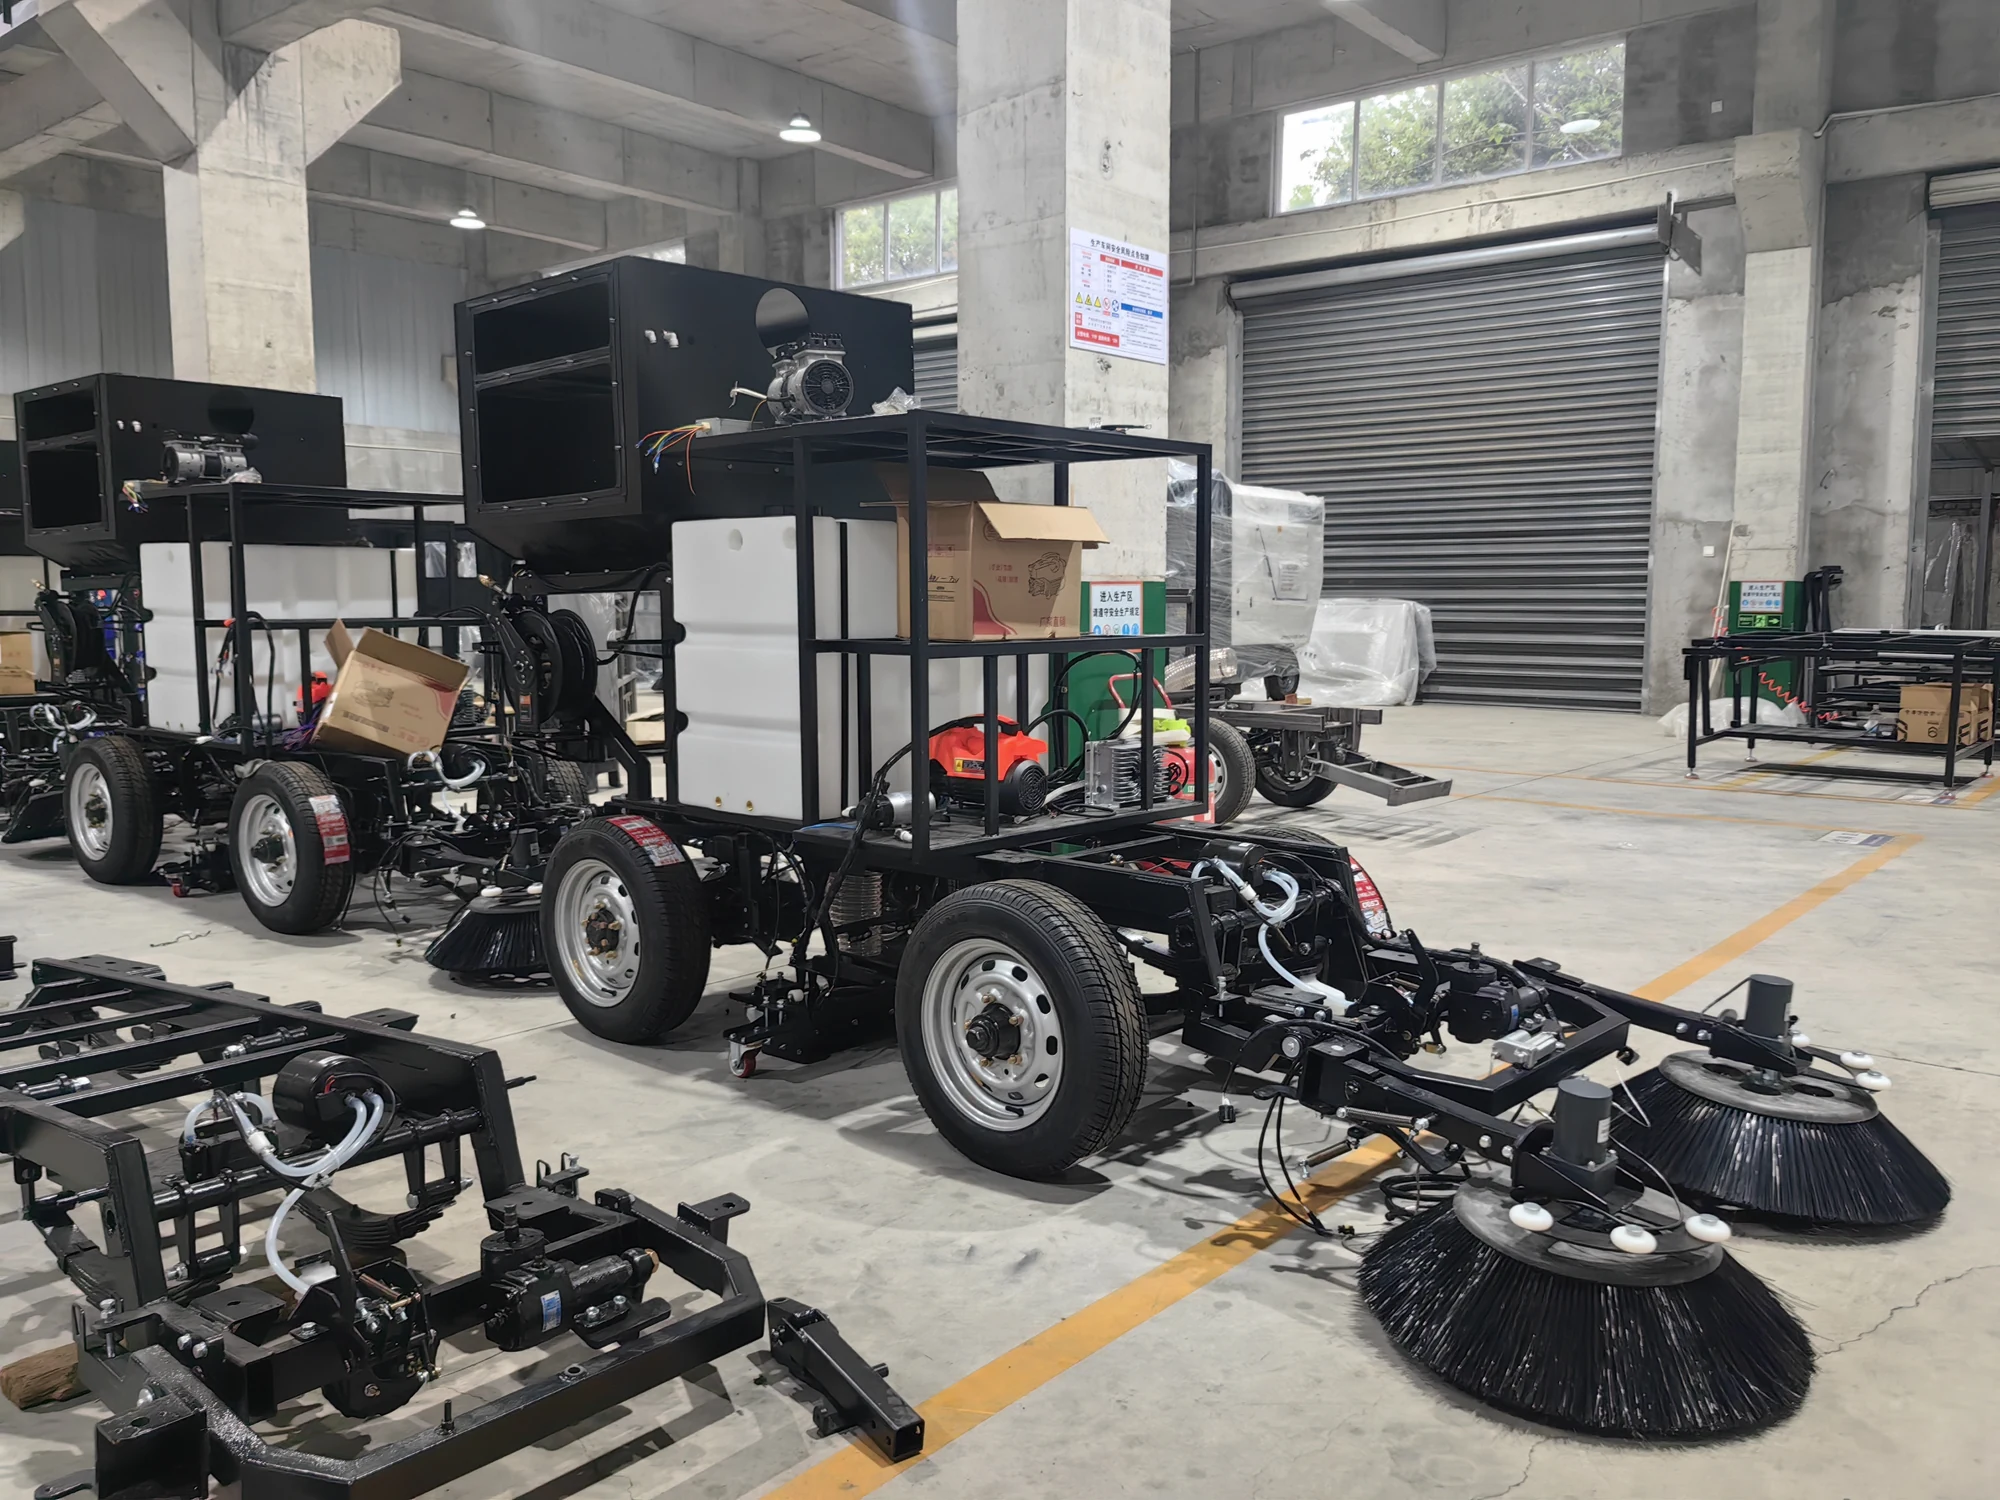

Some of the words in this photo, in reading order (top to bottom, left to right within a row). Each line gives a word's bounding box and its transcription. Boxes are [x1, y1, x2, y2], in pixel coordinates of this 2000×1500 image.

[1100, 590, 1133, 602] 进入生产区
